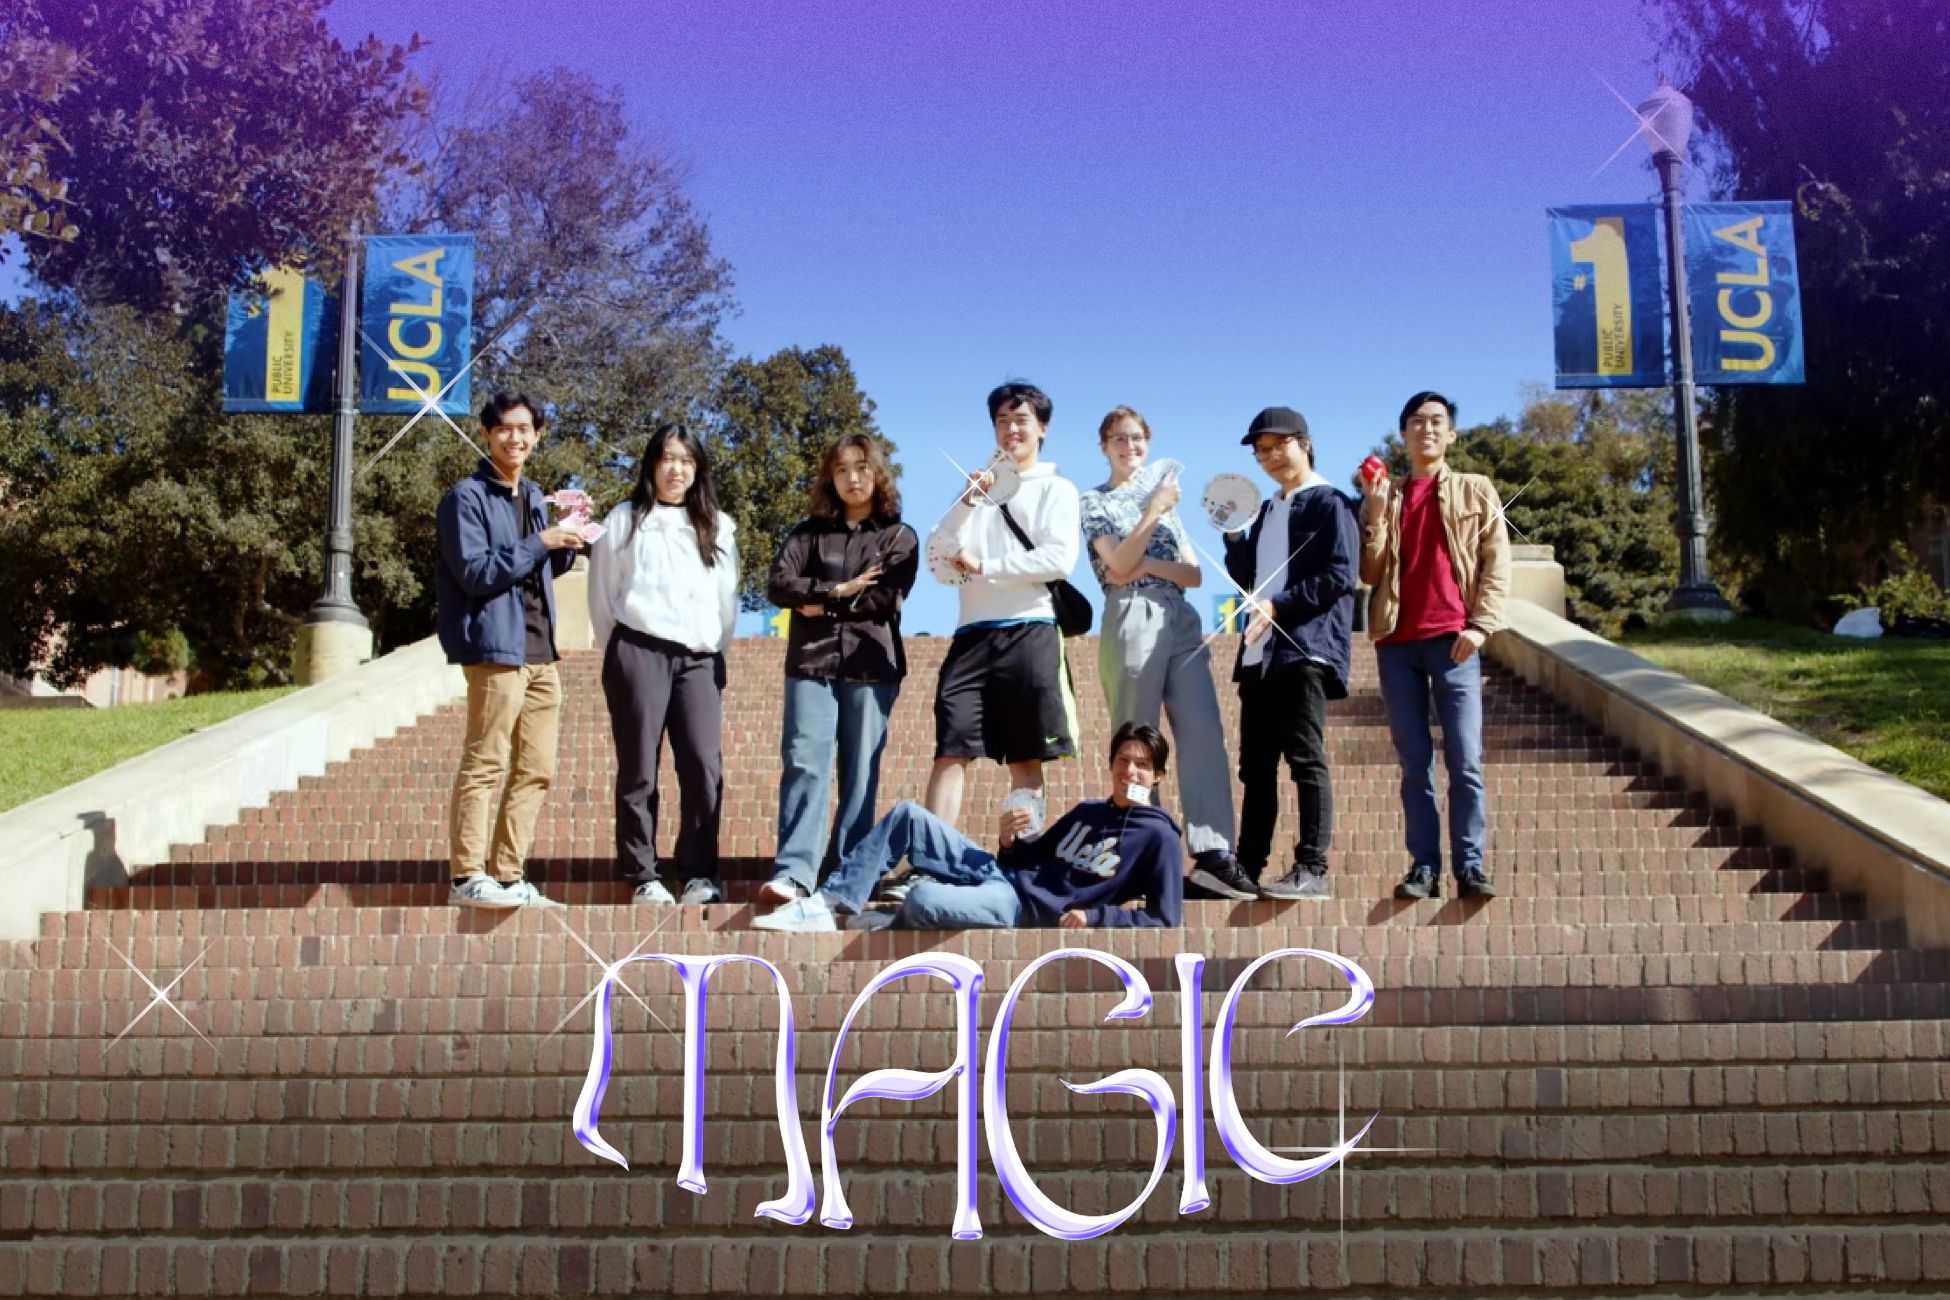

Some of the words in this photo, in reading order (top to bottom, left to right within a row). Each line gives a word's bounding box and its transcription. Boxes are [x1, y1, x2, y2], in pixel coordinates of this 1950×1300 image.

[386, 247, 445, 401] UCLA
[1712, 214, 1775, 371] UCLA
[271, 354, 282, 394] PUBLIC
[282, 331, 294, 395] UNIVERSITY
[1602, 327, 1614, 368] PUBLIC
